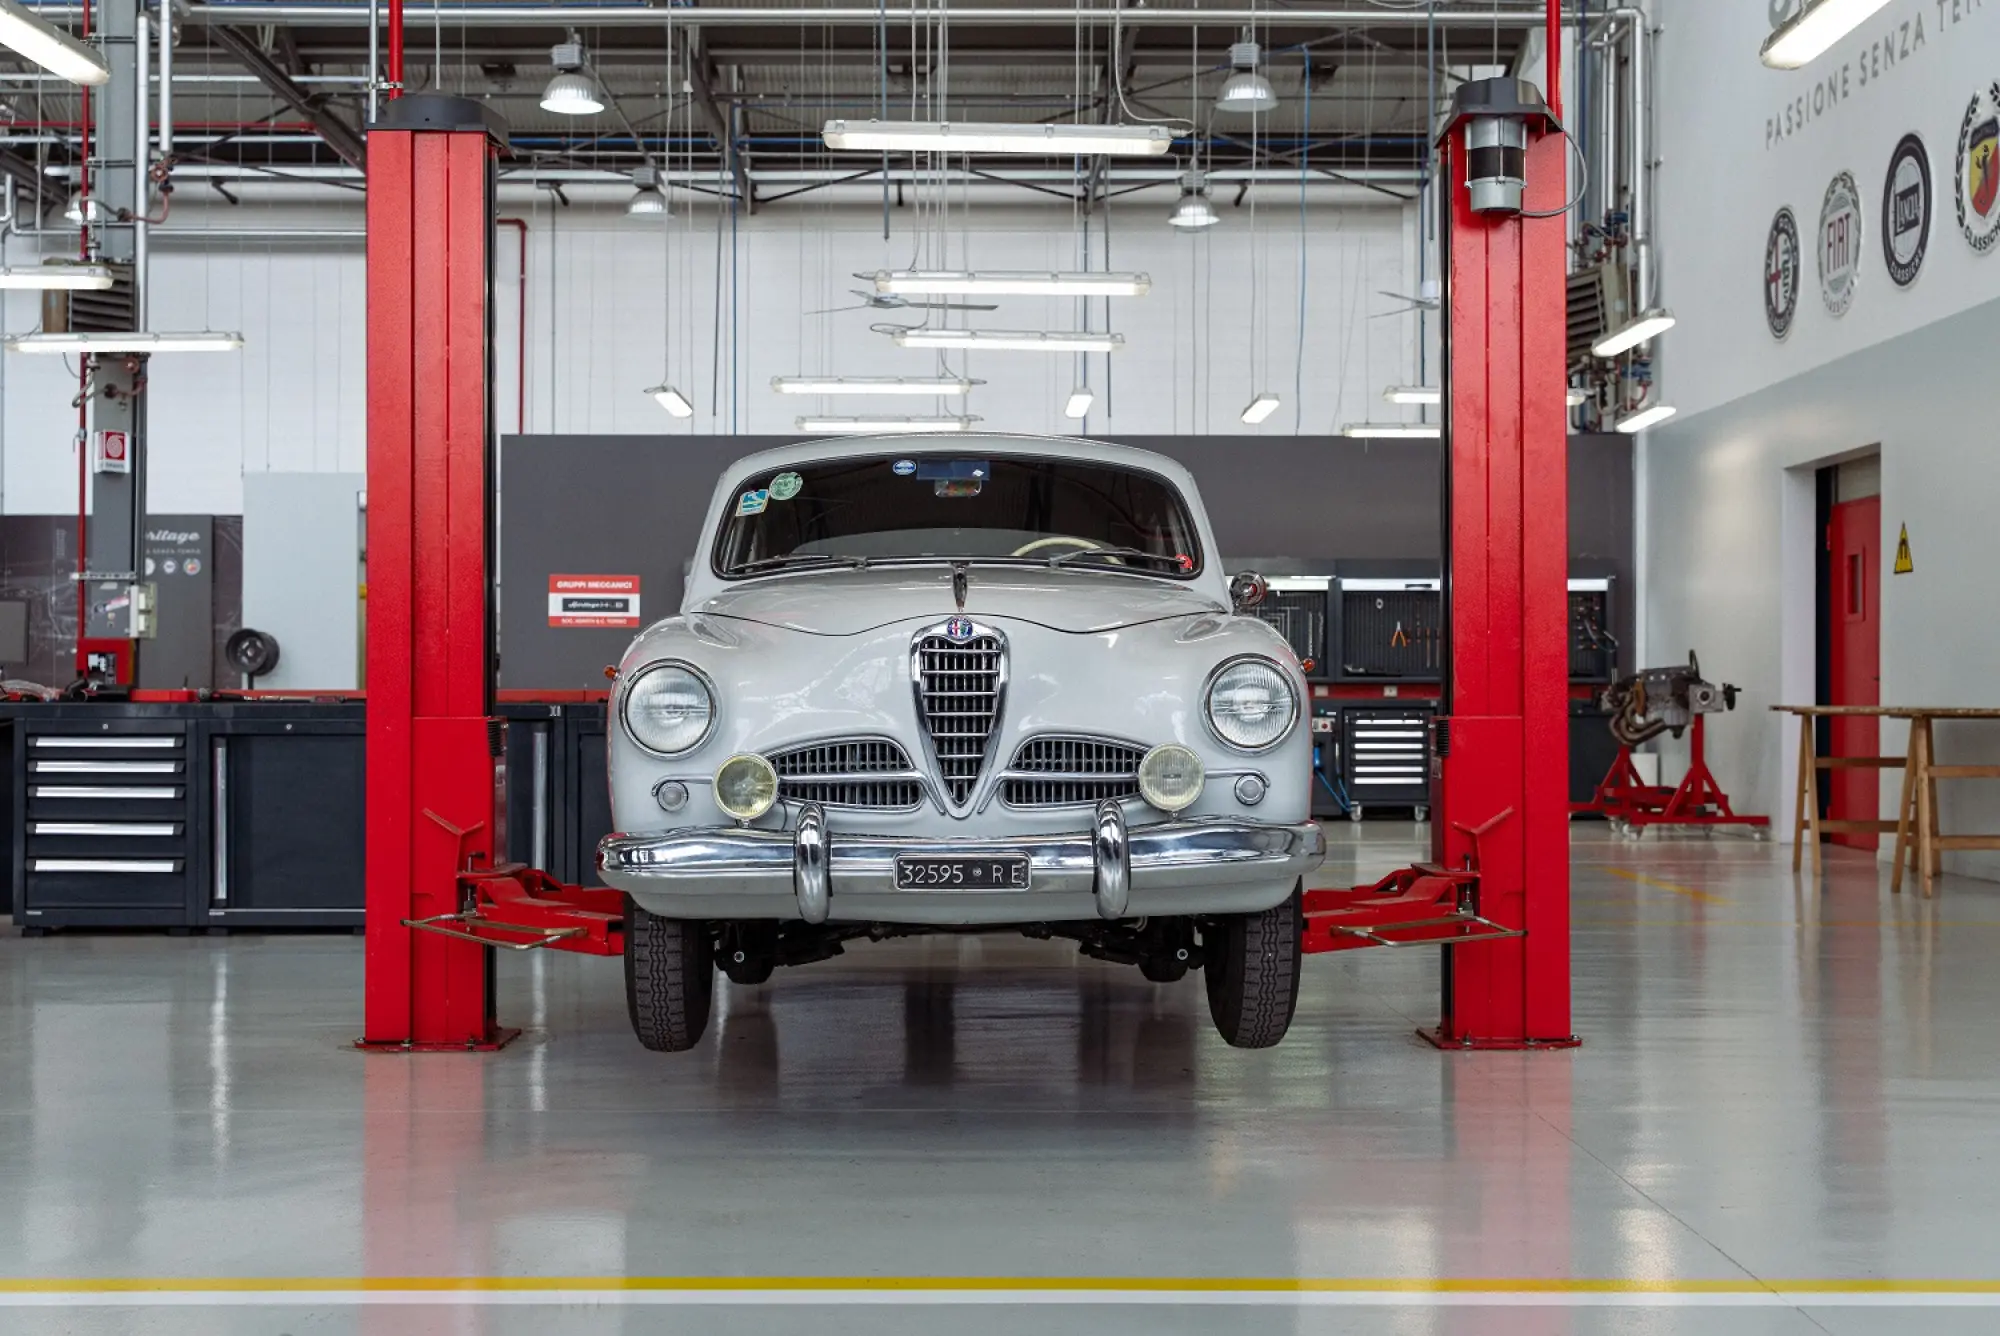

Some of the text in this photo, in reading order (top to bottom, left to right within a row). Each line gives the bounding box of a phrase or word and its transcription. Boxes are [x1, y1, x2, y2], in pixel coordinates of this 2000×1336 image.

[1766, 63, 1849, 150] PASSIONE
[1859, 12, 1925, 86] SENZA
[1827, 212, 1850, 274] FIAT
[1965, 217, 2000, 251] CLASSICH
[557, 581, 632, 589] GRUPPI MECCANICI
[903, 864, 964, 883] 32595
